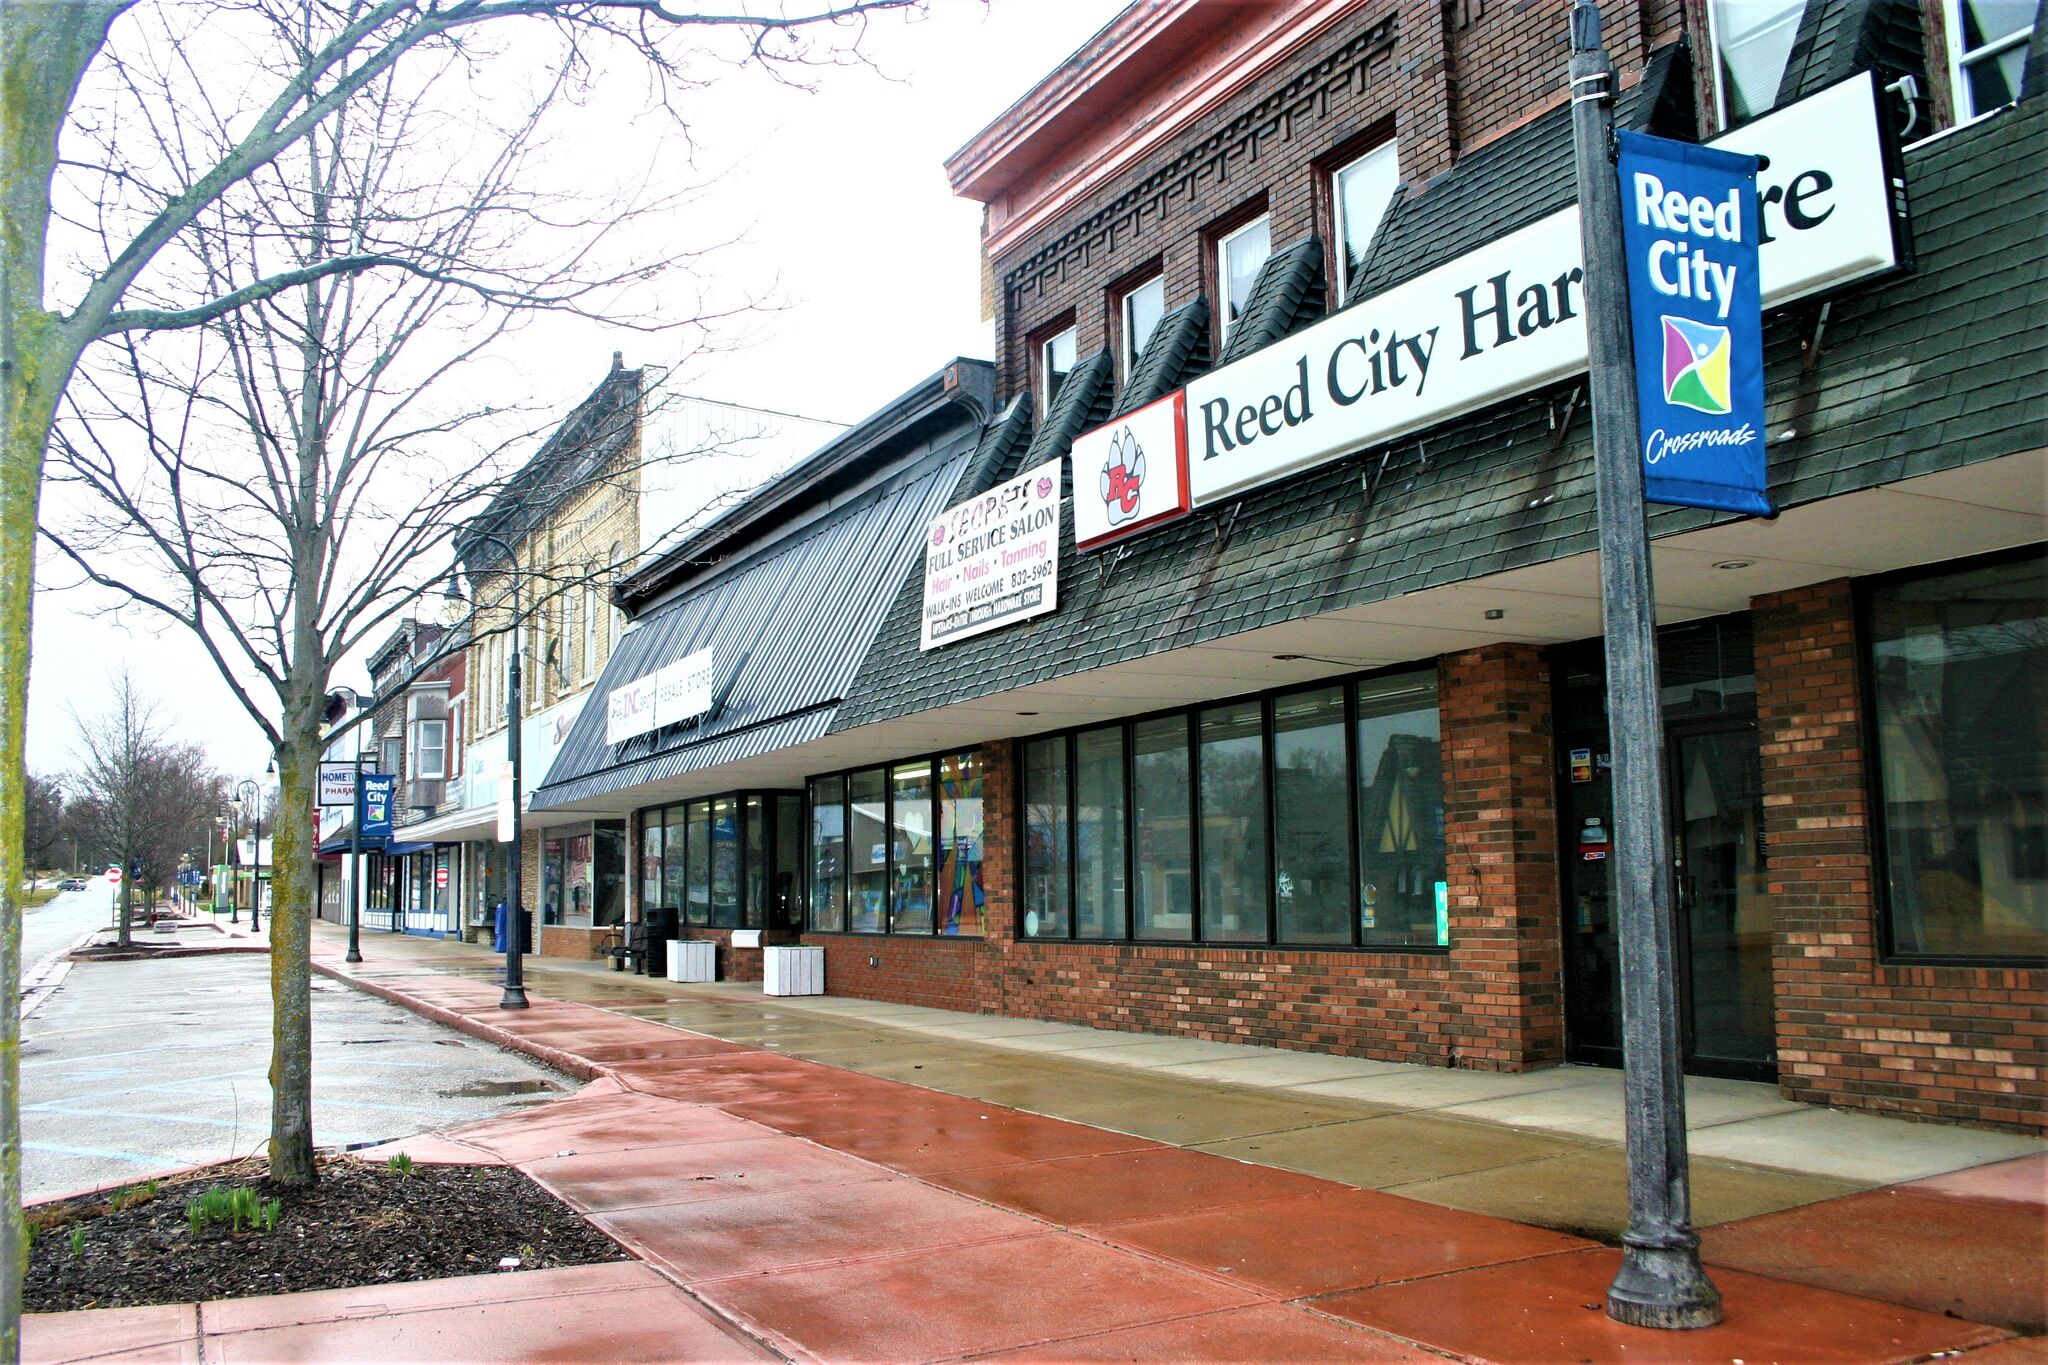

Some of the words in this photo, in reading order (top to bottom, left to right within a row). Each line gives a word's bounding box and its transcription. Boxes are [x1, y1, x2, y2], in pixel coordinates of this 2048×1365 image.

[1632, 171, 1742, 243] Reed
[1647, 238, 1737, 320] City
[1199, 353, 1315, 462] Reed
[1327, 325, 1440, 408] City
[1646, 422, 1758, 465] Crossroads
[1107, 464, 1140, 513] RC
[928, 549, 953, 575] FULL
[958, 524, 1006, 562] SERVICE
[1009, 504, 1055, 541] SALON
[925, 594, 962, 619] WALK-INS
[965, 578, 1004, 603] WELCOME
[1011, 560, 1053, 588] 832-5962
[931, 574, 953, 596] Hair
[962, 560, 990, 583] Nails
[1000, 539, 1047, 569] Tanning
[1023, 587, 1041, 606] STORE
[687, 667, 711, 693] STORE
[365, 780, 389, 791] Reed
[367, 791, 387, 804] City
